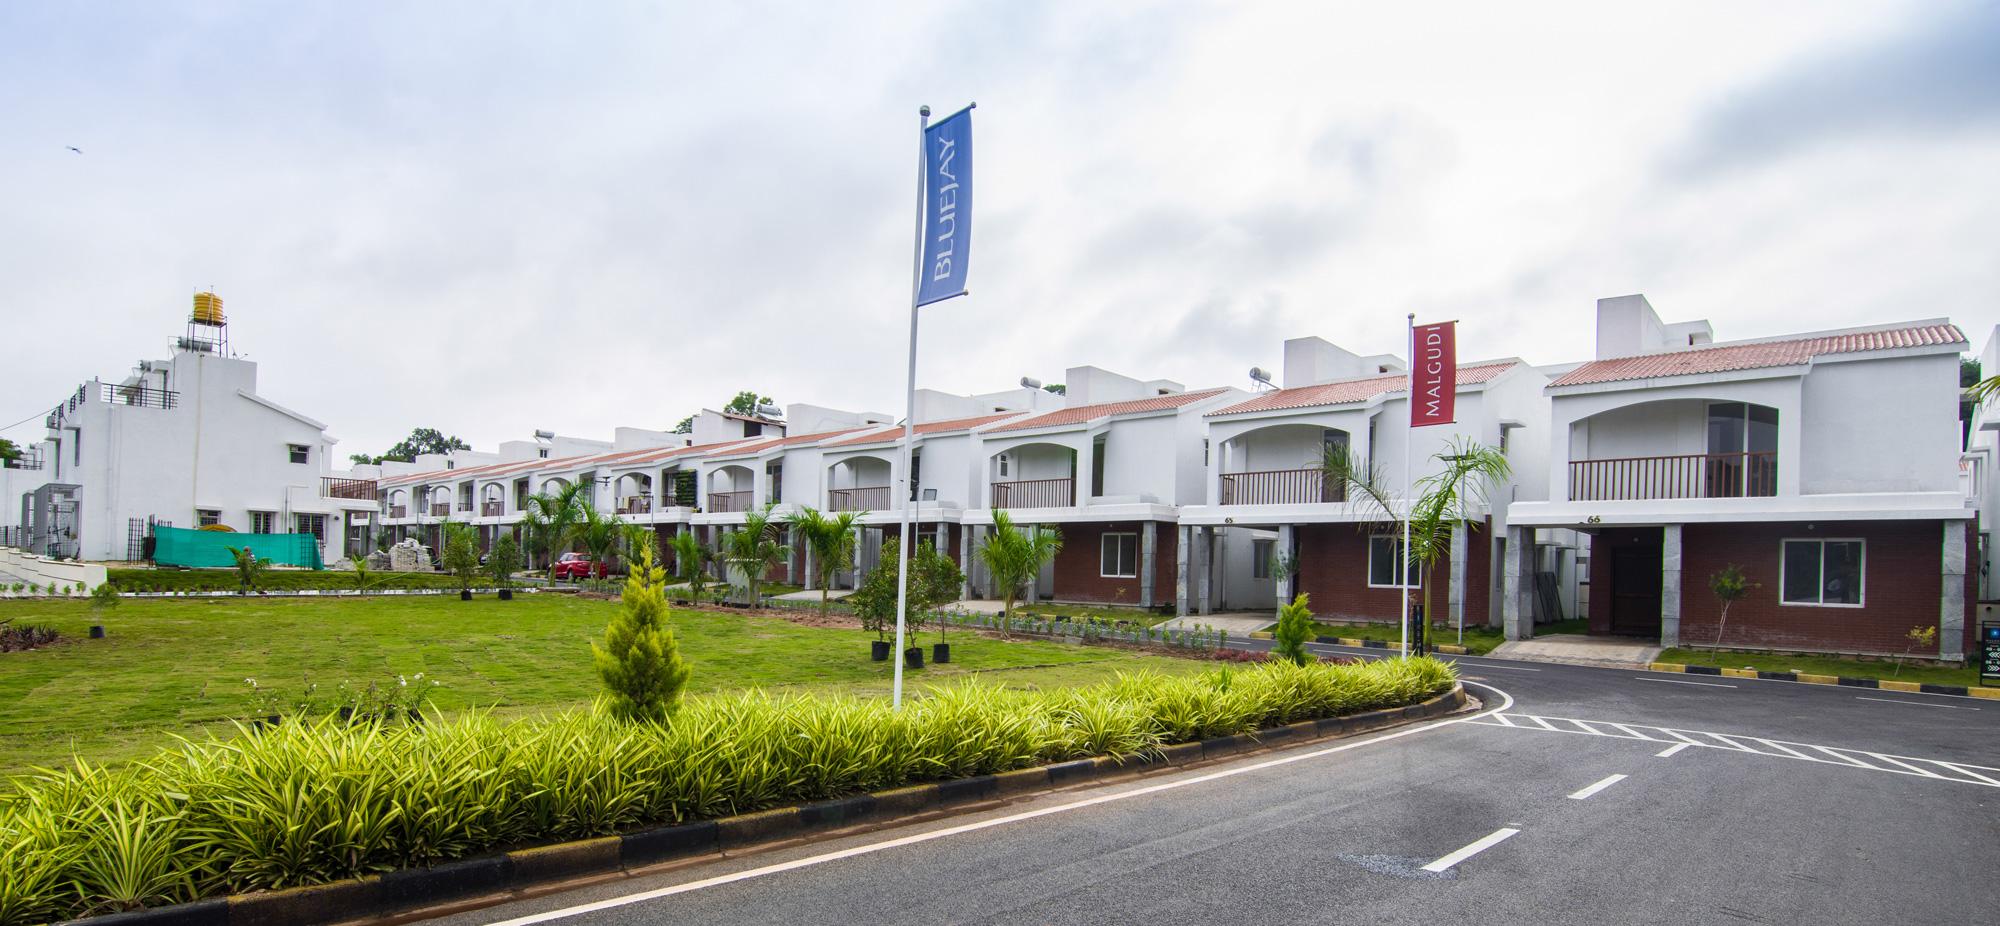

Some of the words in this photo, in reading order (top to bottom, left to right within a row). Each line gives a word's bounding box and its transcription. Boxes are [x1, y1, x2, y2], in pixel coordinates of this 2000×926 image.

[934, 136, 959, 282] BLUEJAY
[1426, 326, 1442, 417] MALGUDI
[1587, 515, 1601, 524] 66
